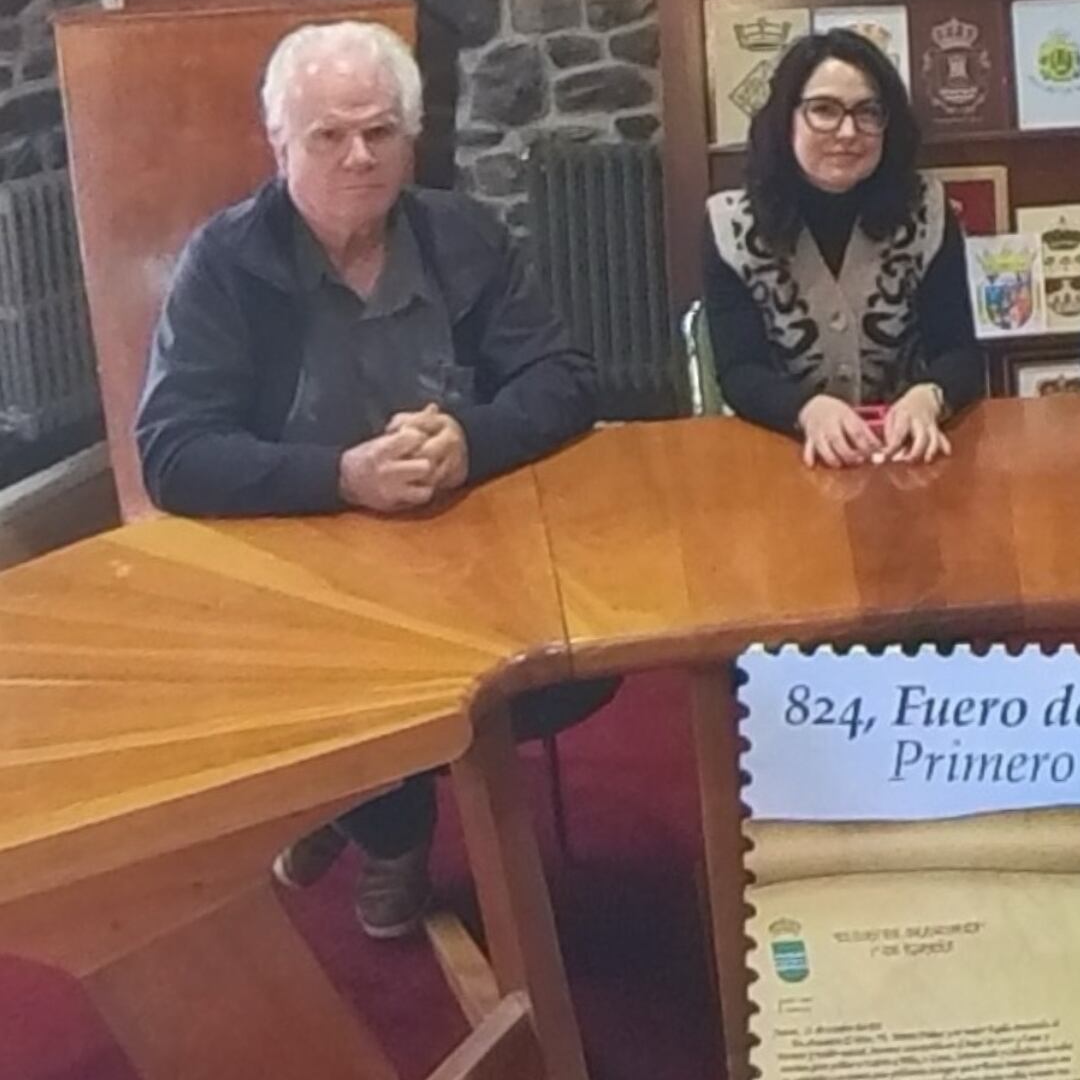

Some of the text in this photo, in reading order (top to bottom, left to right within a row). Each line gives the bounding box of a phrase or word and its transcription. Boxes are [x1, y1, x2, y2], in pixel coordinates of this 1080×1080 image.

[784, 683, 877, 741] 824,
[890, 684, 1028, 728] Fuero
[887, 738, 1075, 783] Primero
